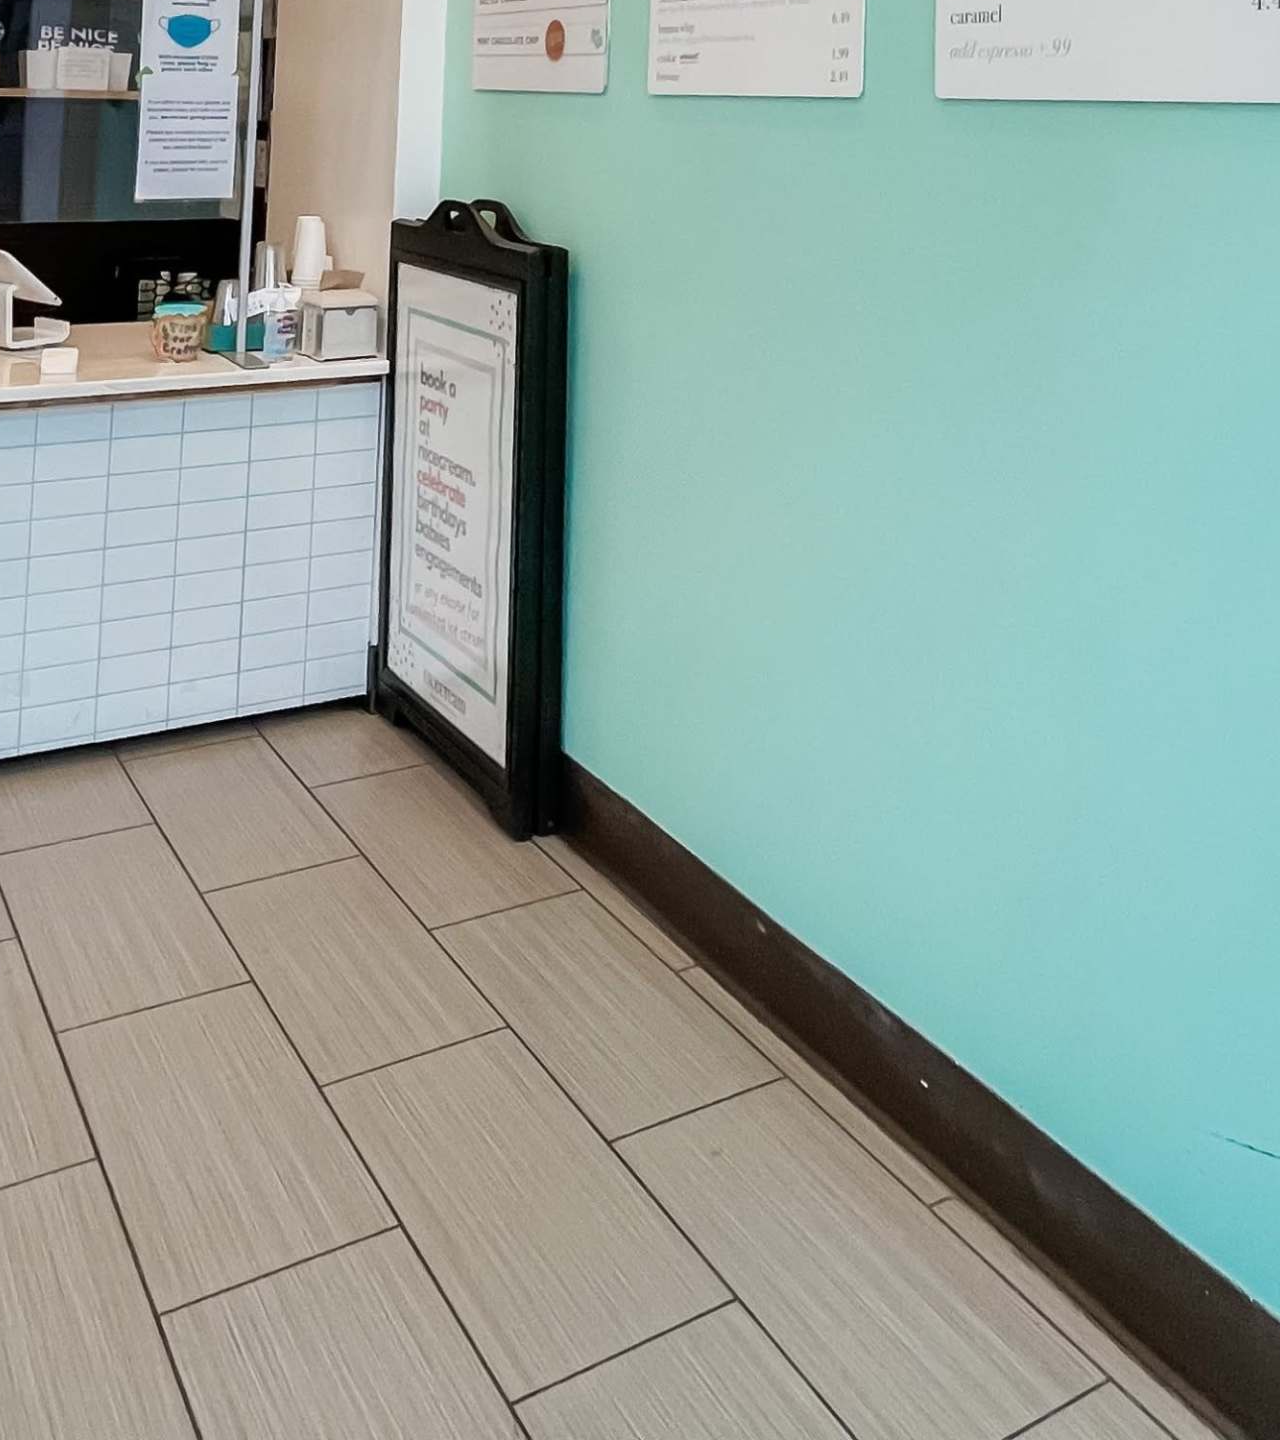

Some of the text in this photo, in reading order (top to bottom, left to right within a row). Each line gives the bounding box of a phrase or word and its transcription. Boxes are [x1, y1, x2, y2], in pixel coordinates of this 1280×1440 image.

[950, 4, 1003, 25] caramel
[40, 25, 118, 43] BE NICE
[421, 360, 456, 398] book a
[420, 395, 449, 426] party
[419, 418, 430, 437] at
